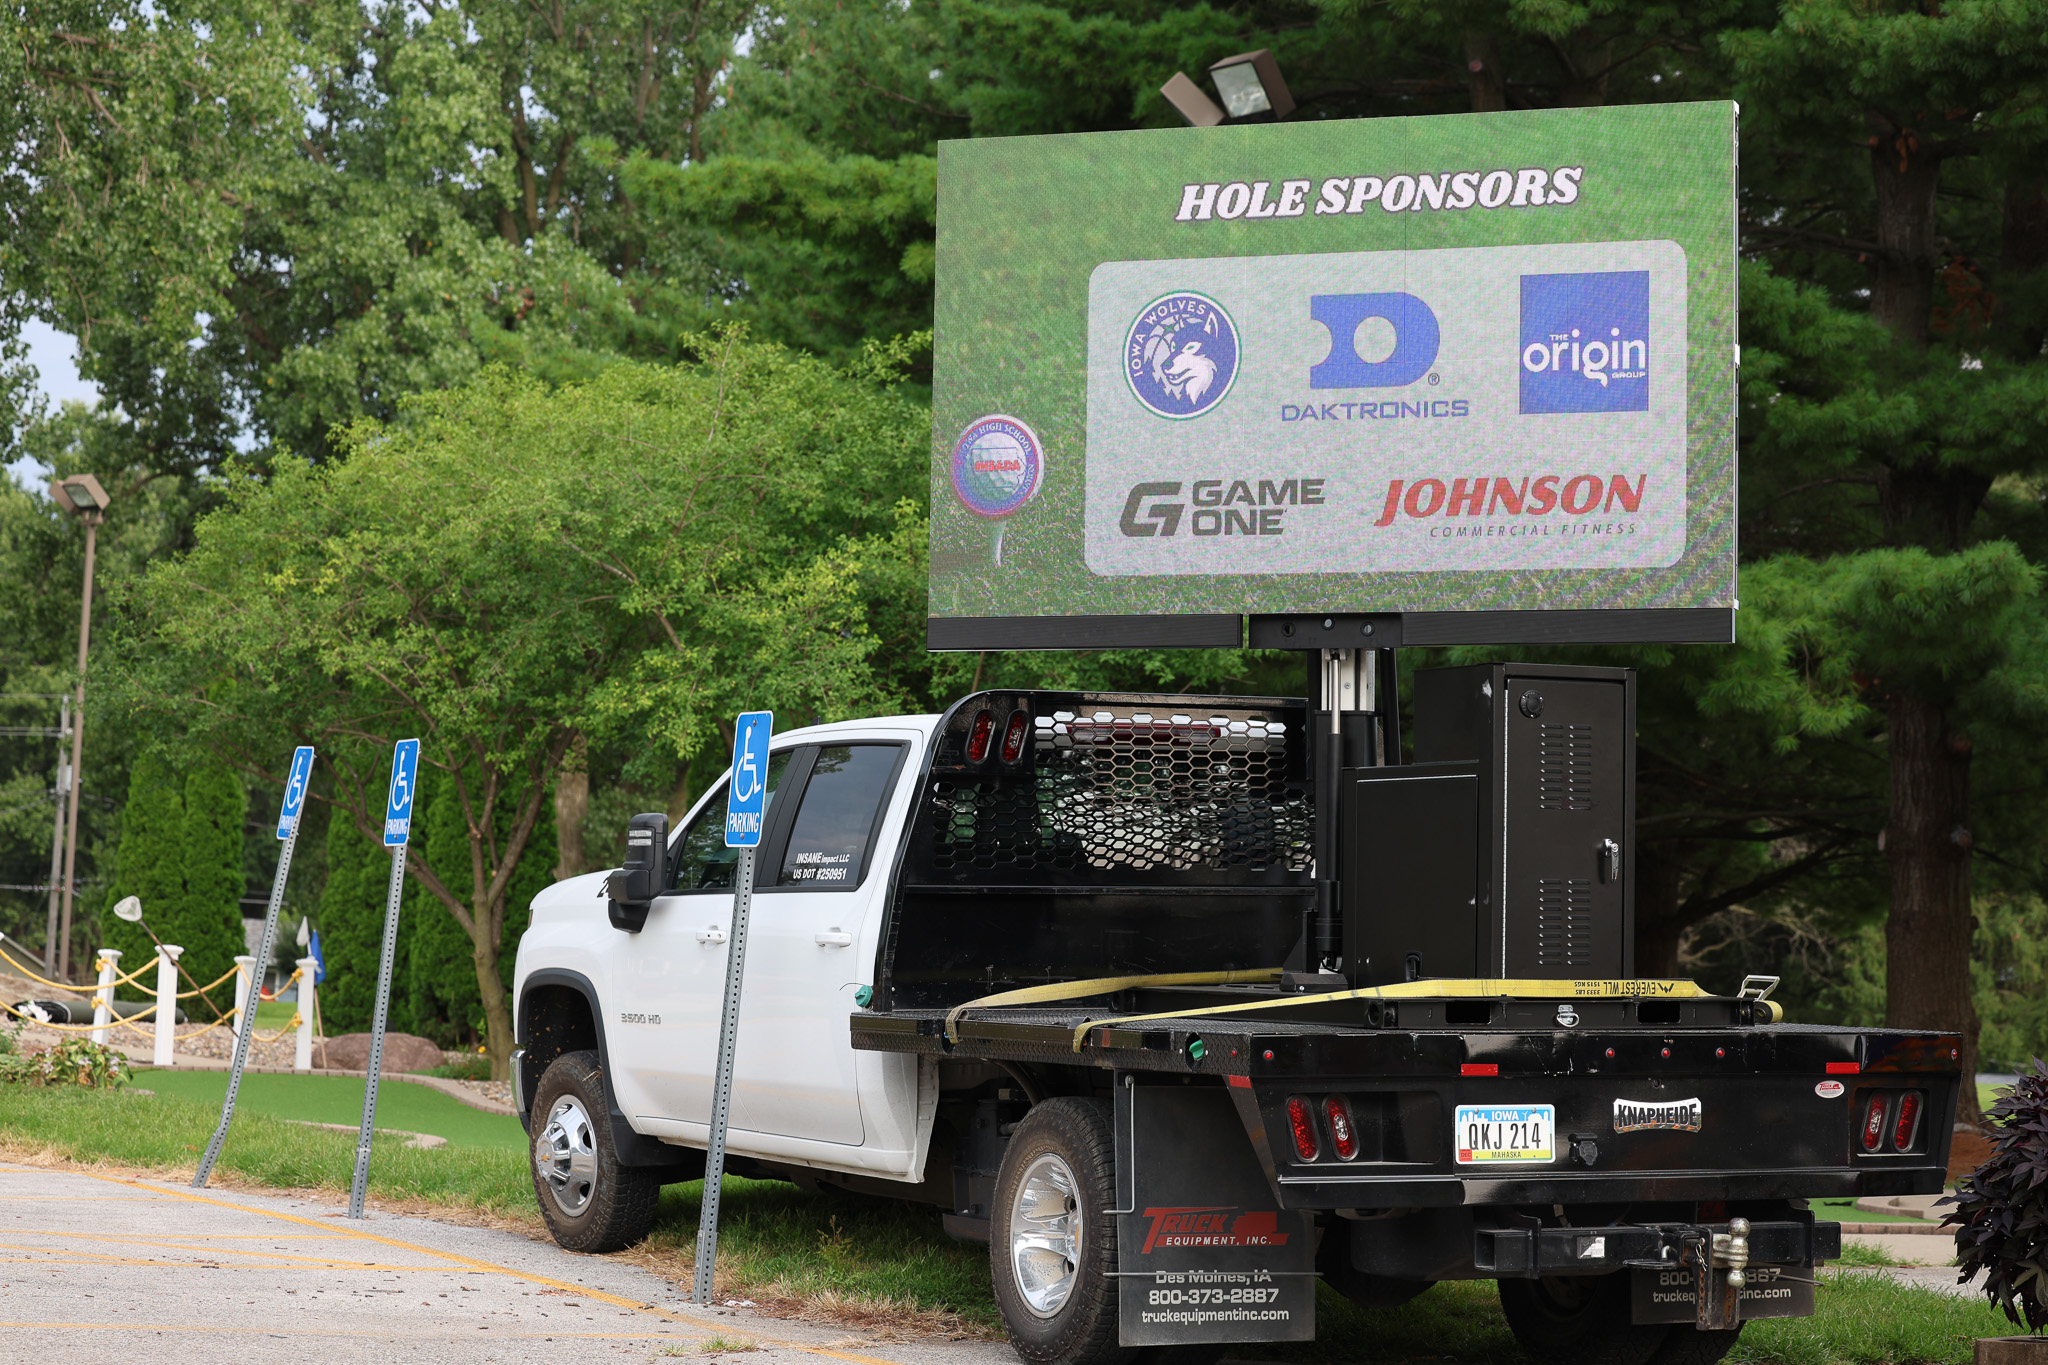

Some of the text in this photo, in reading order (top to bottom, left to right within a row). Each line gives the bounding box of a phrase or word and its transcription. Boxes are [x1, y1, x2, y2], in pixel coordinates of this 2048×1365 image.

[1174, 166, 1584, 221] HOLE SPONSORS
[1131, 299, 1207, 378] IOWA WOLVES
[1523, 327, 1646, 388] origin
[1611, 371, 1646, 379] GROUP
[1281, 399, 1470, 422] DAKTRONICS
[1004, 424, 1032, 454] SCHOOL
[1192, 478, 1326, 507] GAME
[1373, 474, 1648, 527] JOHNSON
[1192, 508, 1285, 536] ONE
[1430, 523, 1637, 538] COMMERCIAL FITNESS
[386, 818, 409, 835] PARKING
[728, 812, 760, 833] PARKING
[796, 851, 850, 865] INSANE impact LLC
[793, 867, 847, 880] US DOT #250951
[1603, 982, 1656, 995] EVEREST WLL
[621, 1013, 661, 1025] 3500 HD
[1491, 1110, 1519, 1121] IOWA
[1618, 1103, 1697, 1128] KNAPHEIDE
[1468, 1123, 1541, 1150] QKJ 214
[1141, 1206, 1238, 1254] TRUCK
[1166, 1236, 1272, 1246] EQUIPMENT, INC.
[1155, 1270, 1185, 1284] Des
[1188, 1269, 1251, 1286] Moines,
[1149, 1288, 1280, 1305] 800-373-2887
[1141, 1308, 1290, 1326] truckequipmentinc.com
